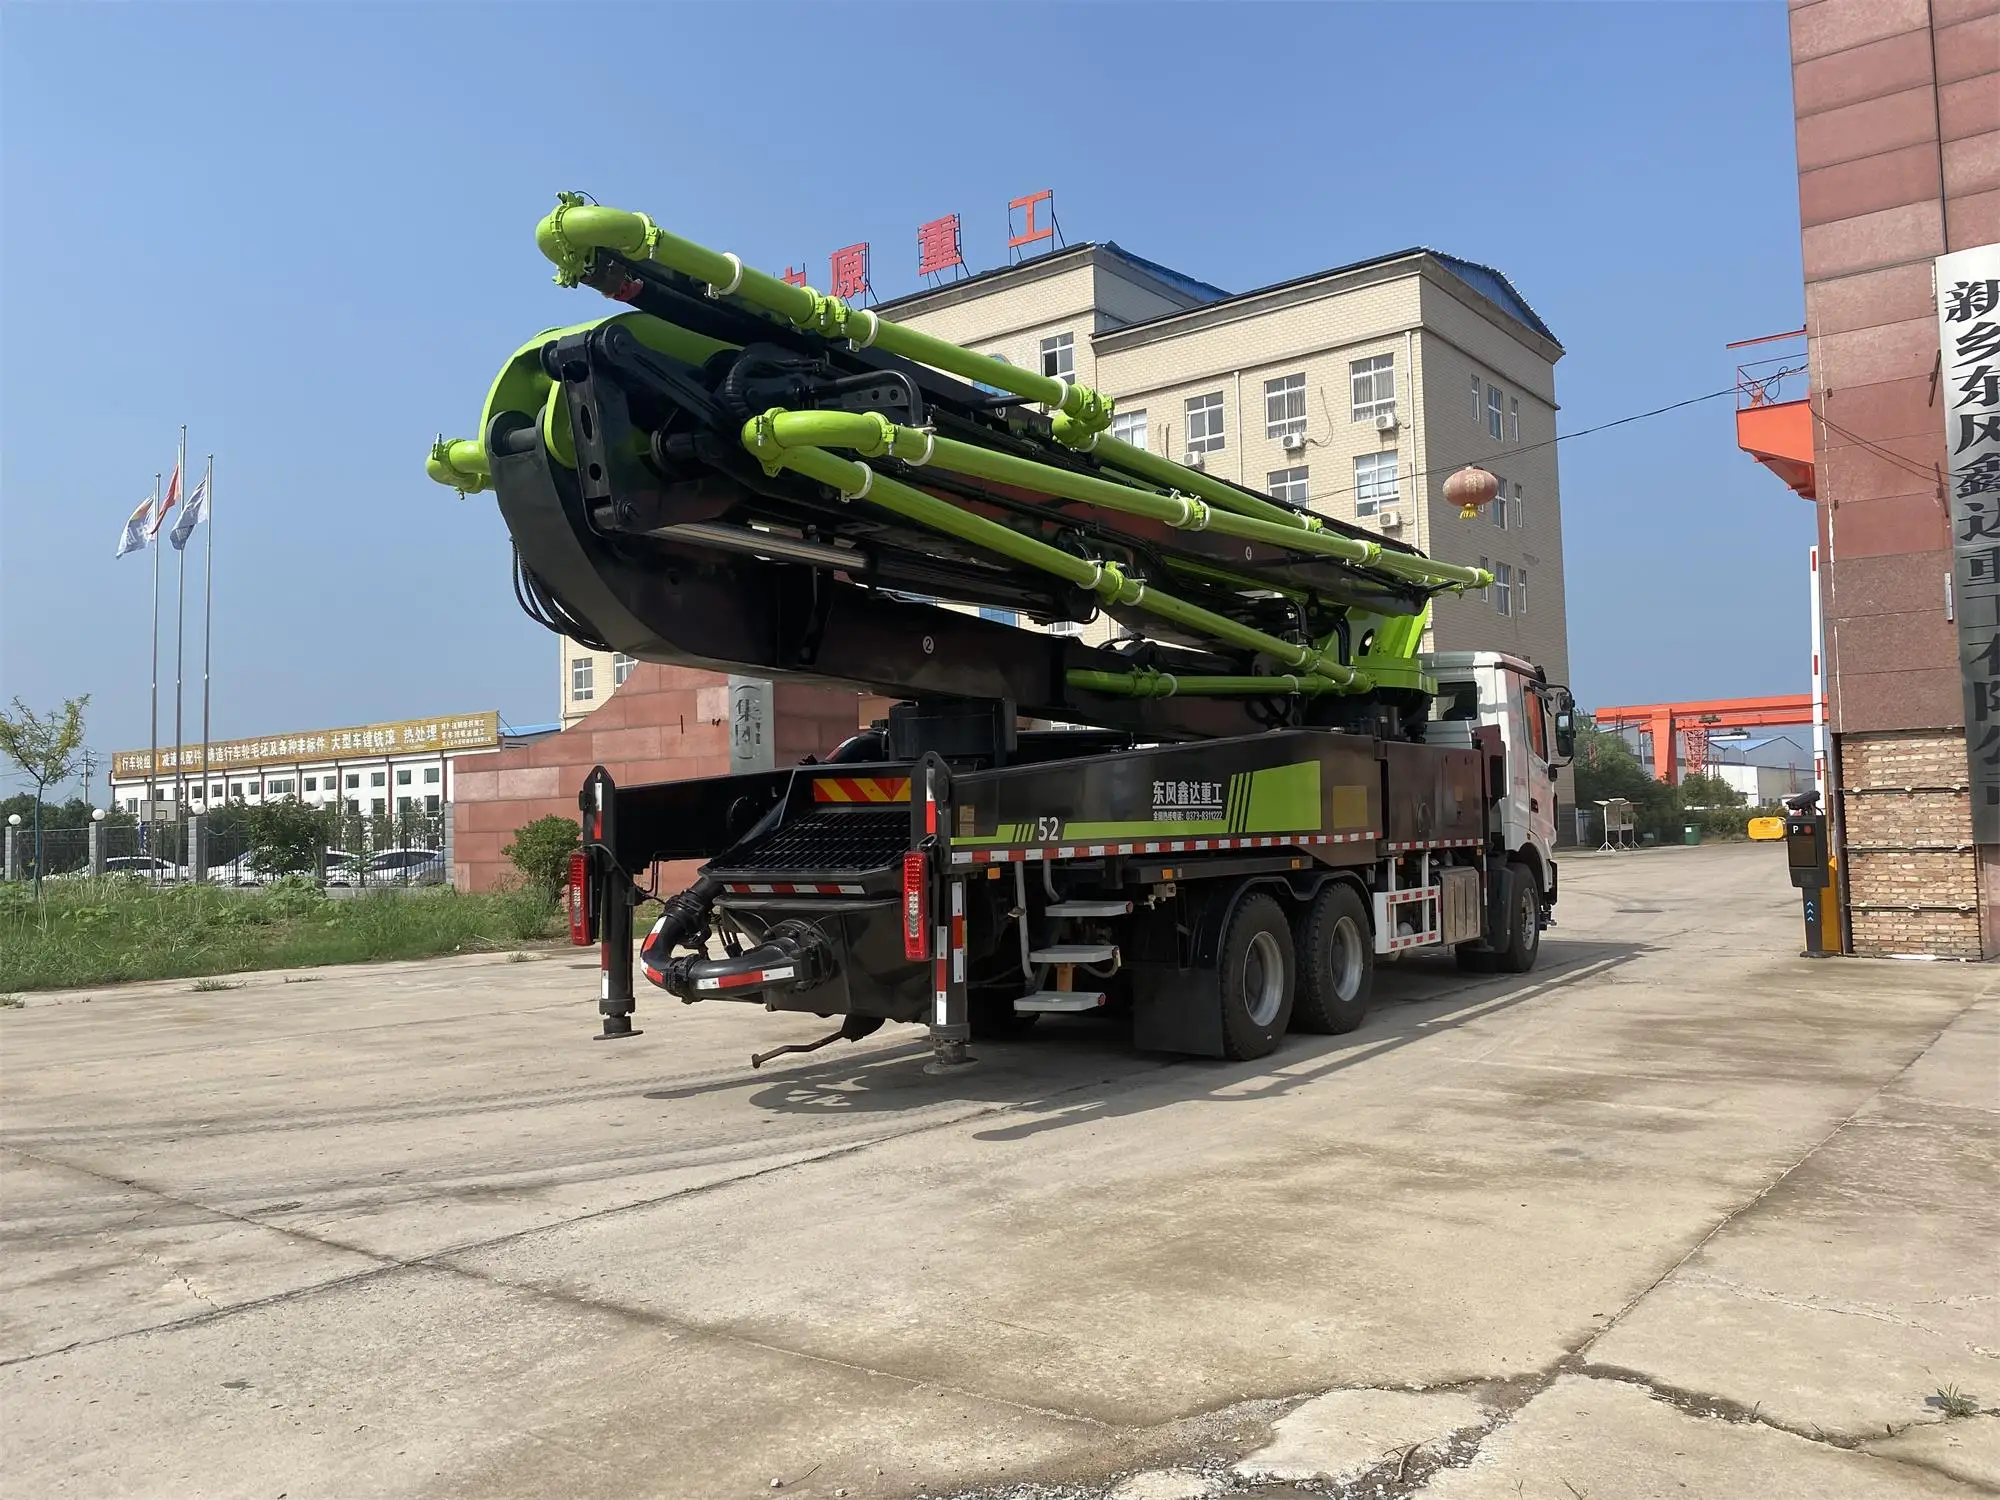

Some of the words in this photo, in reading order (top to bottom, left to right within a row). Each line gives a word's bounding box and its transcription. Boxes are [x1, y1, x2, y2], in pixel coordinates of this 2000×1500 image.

[1152, 780, 1223, 804] 东风鑫达重工
[1038, 816, 1059, 841] 52
[1792, 825, 1799, 834] P
